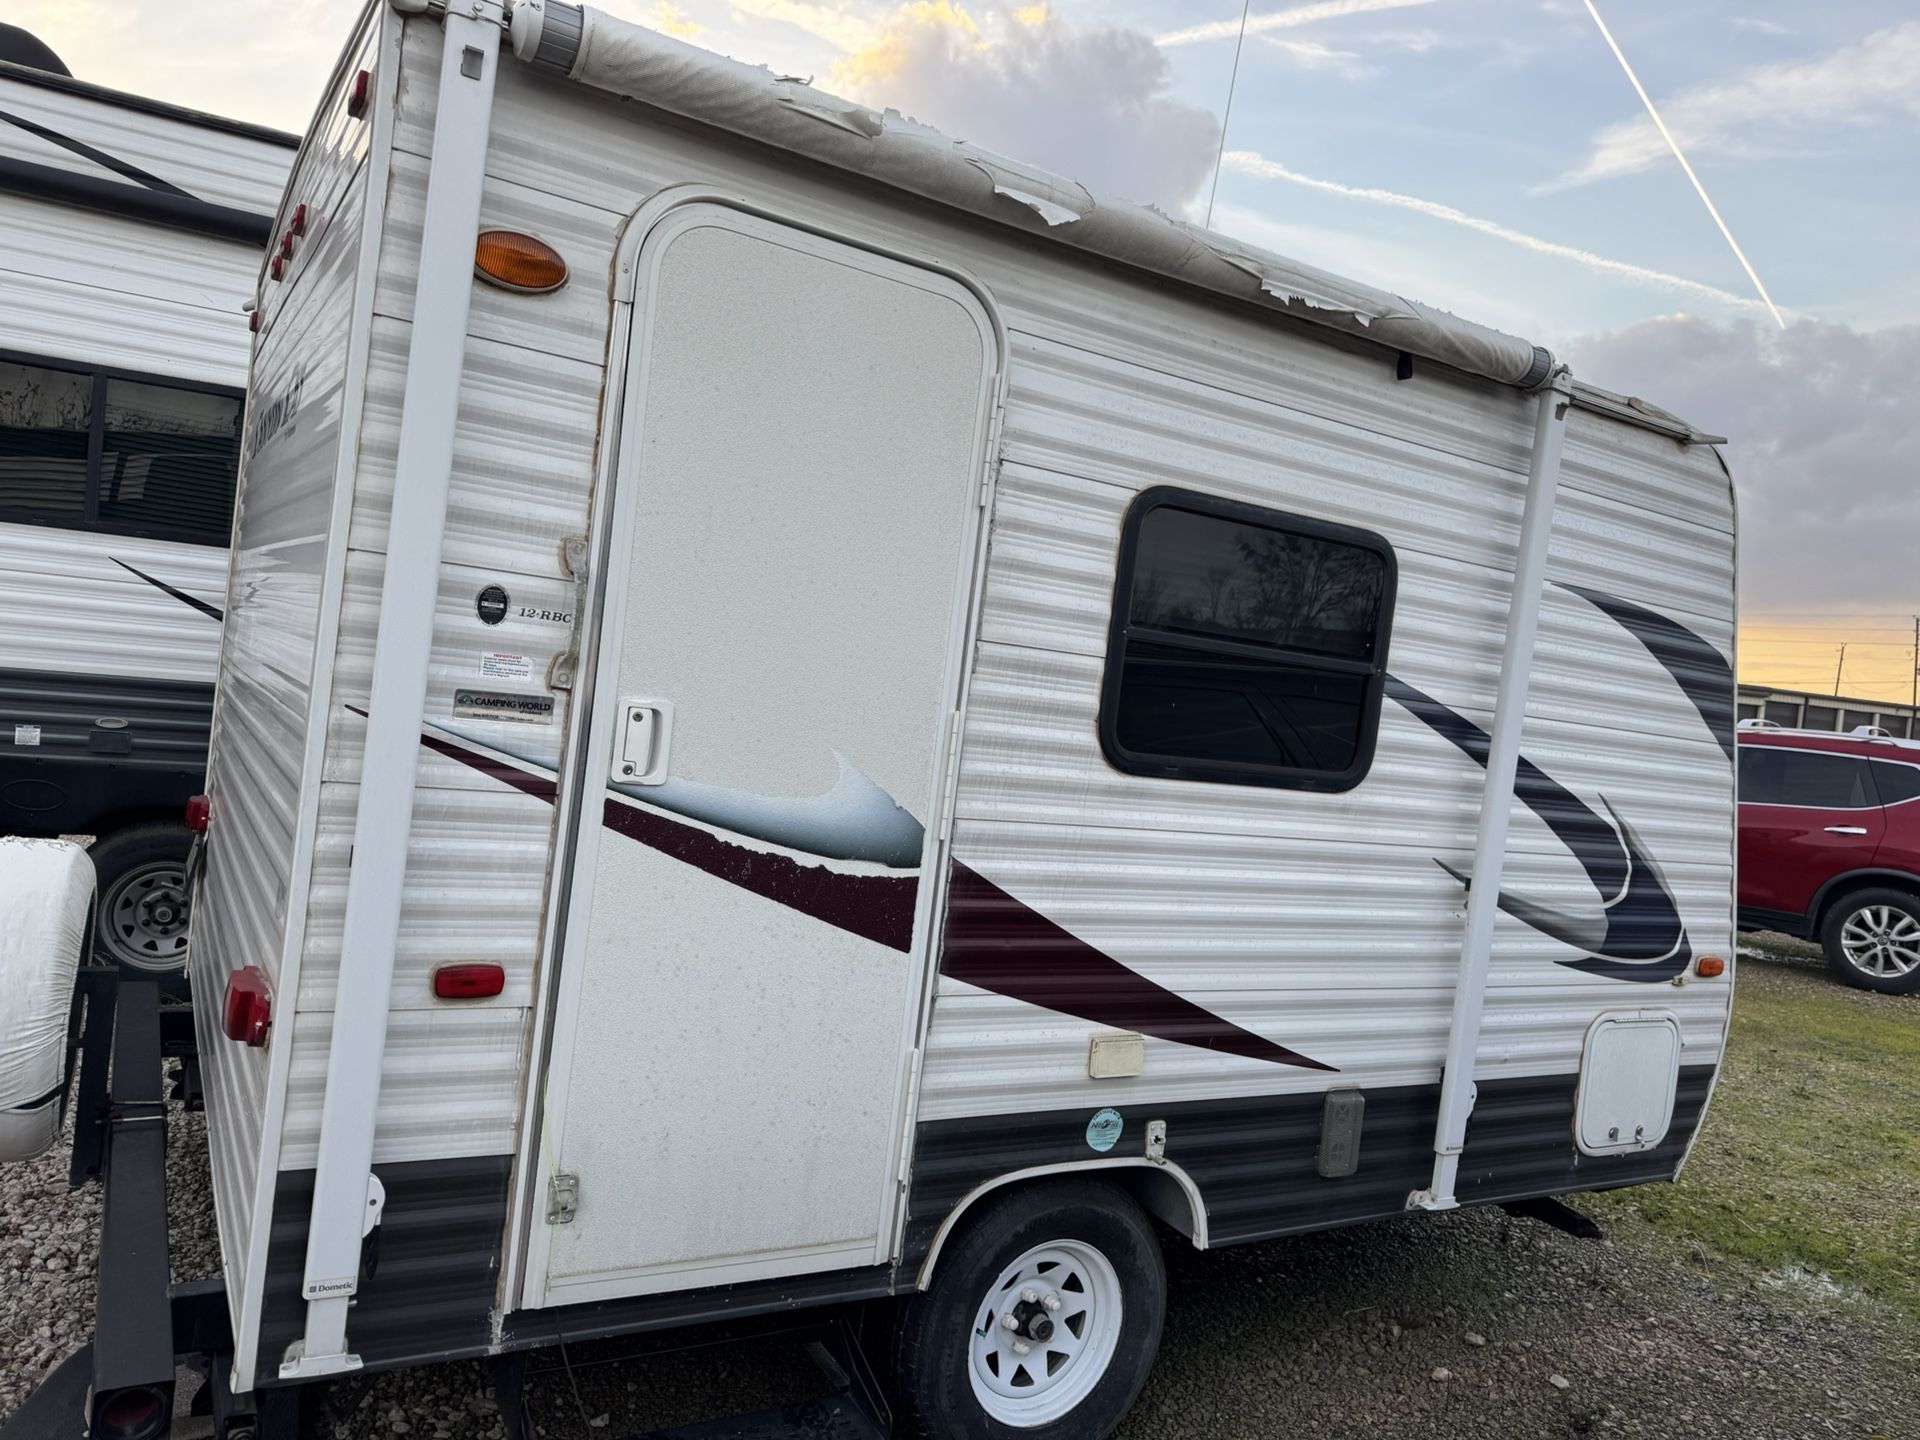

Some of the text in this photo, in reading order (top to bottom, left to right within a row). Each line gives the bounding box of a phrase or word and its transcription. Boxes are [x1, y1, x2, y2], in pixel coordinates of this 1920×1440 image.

[474, 697, 551, 711] CAMPING WORLD
[318, 1282, 353, 1292] Dometic
